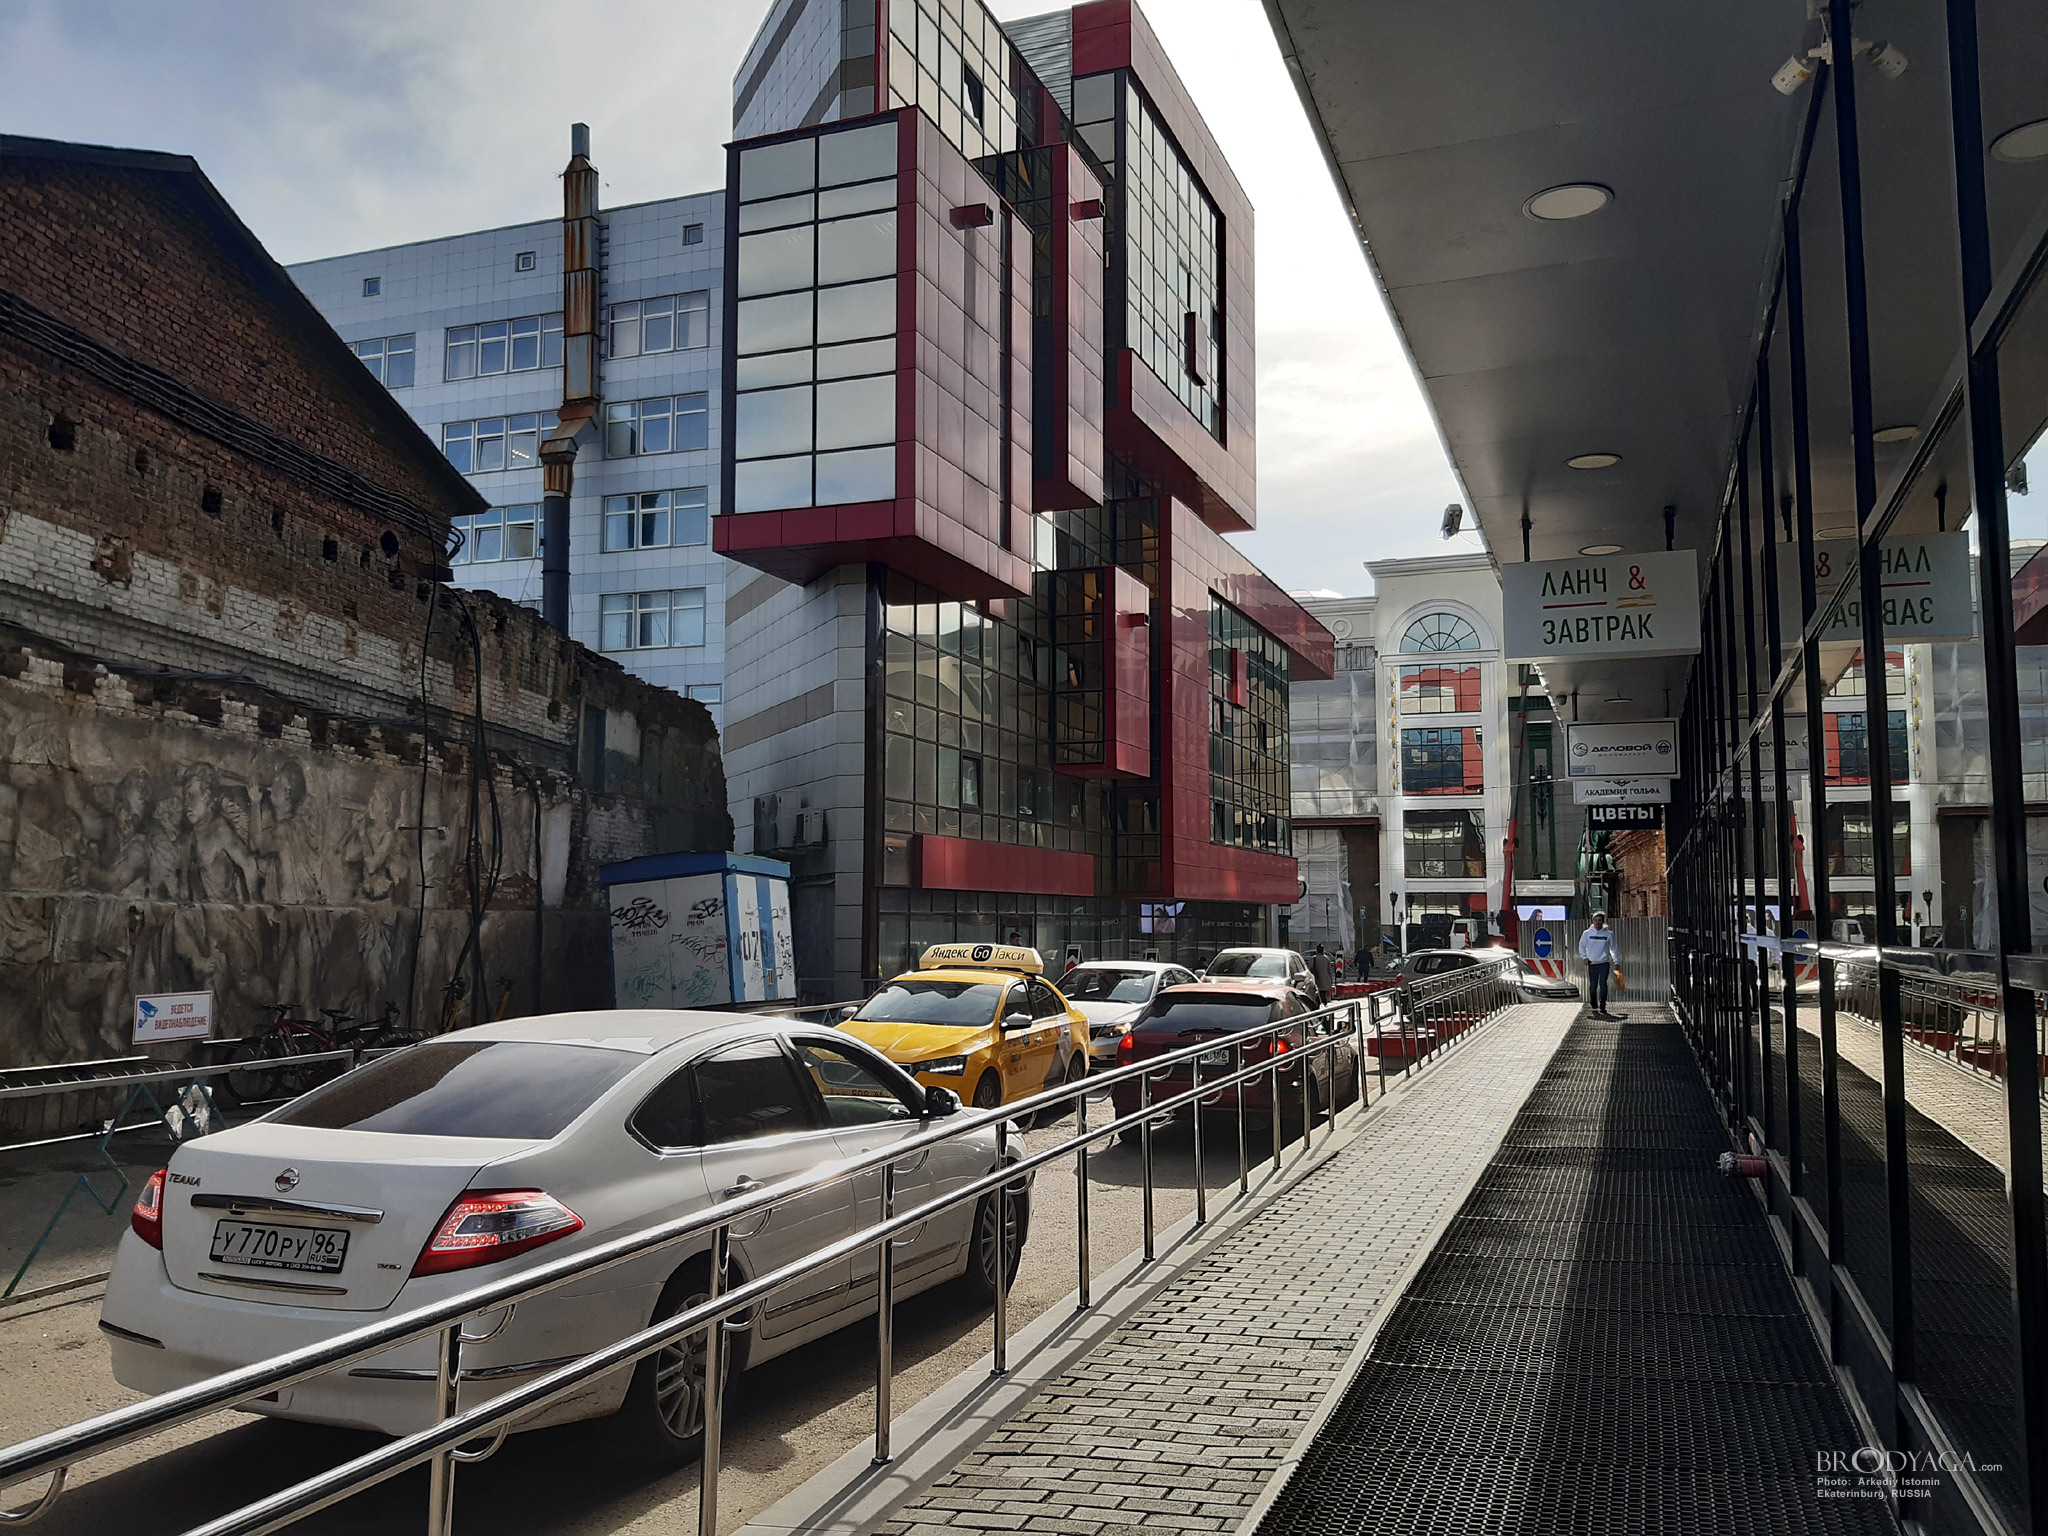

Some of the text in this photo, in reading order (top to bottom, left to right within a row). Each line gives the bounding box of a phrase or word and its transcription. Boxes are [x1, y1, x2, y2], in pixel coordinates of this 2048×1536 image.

[1541, 564, 1647, 597] ЛАНЧ &
[1541, 613, 1655, 645] ЗАВТРАК
[1591, 743, 1653, 753] ДЕЛОВОЙ
[1584, 786, 1661, 796] АКАДЕМИЯ ГОЛЬФА
[1592, 806, 1655, 823] ЦВЕТЫ
[930, 946, 1026, 961] Яндекс Go Такси
[170, 1002, 194, 1015] ВЕДЕТСЯ
[154, 1016, 207, 1030] ВИДЕОНАБЛЮДЕНИЕ
[168, 1172, 202, 1187] TEANA
[314, 1233, 336, 1255] 96
[310, 1253, 327, 1263] RUS
